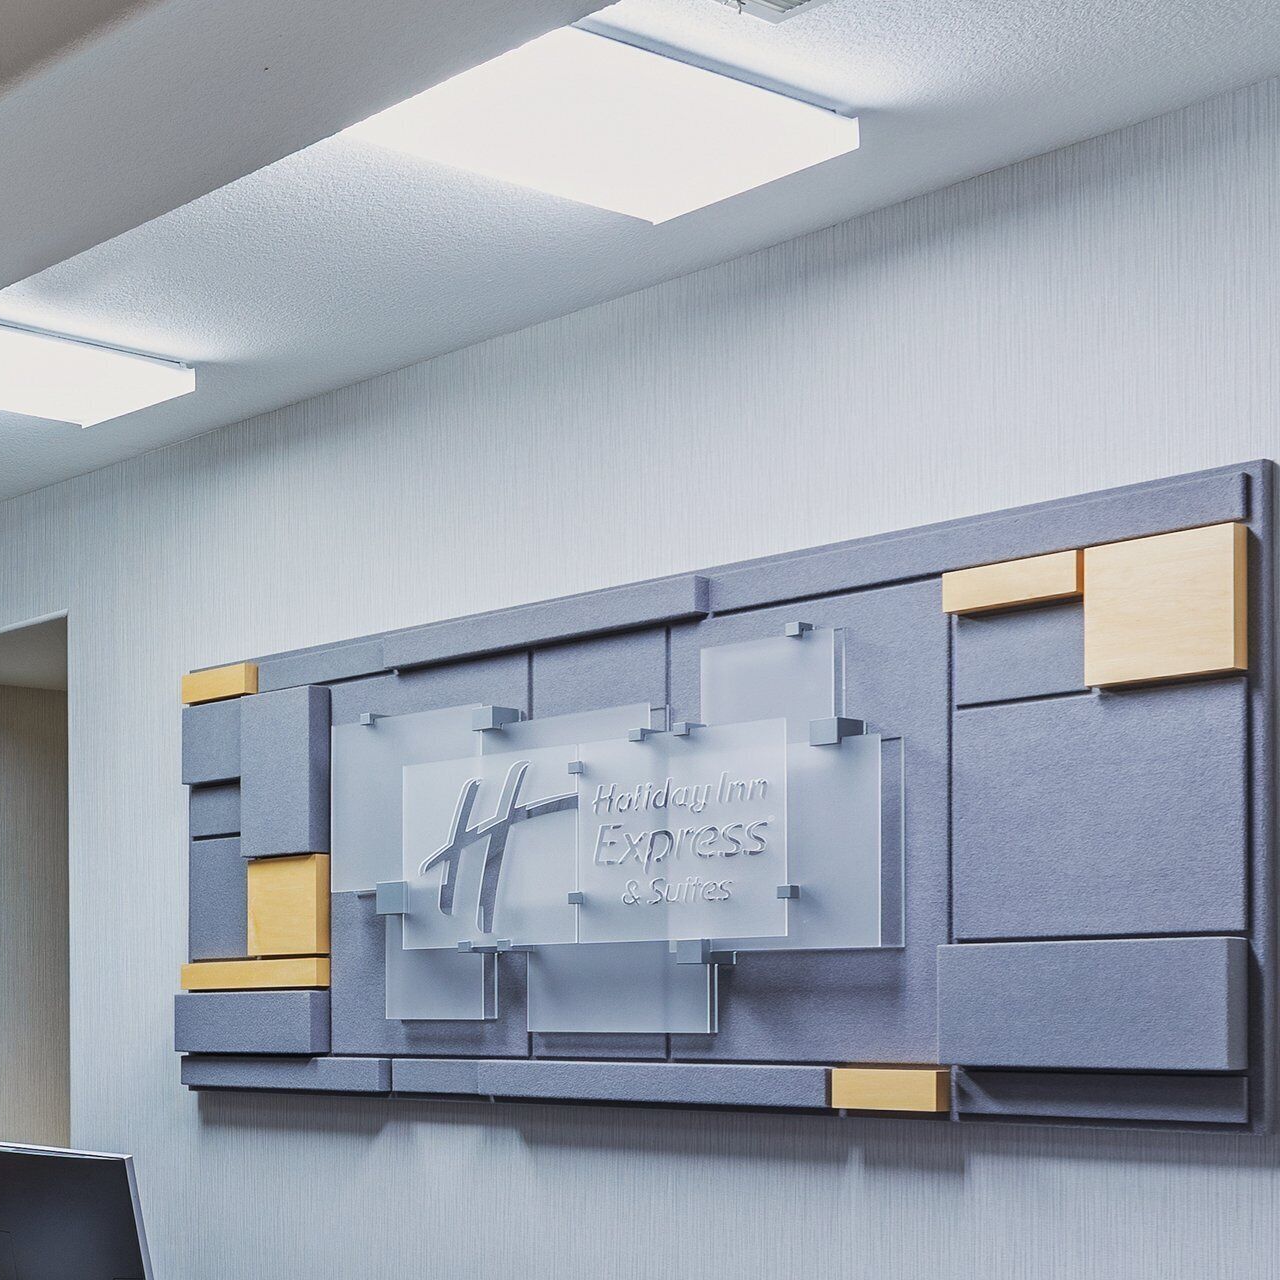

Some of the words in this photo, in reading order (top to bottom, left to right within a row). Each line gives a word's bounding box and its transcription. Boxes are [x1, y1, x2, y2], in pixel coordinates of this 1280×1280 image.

[592, 776, 712, 815] Holiday
[716, 771, 768, 803] Inn
[593, 820, 769, 874] Express
[622, 879, 640, 906] &
[647, 875, 734, 905] Suites
